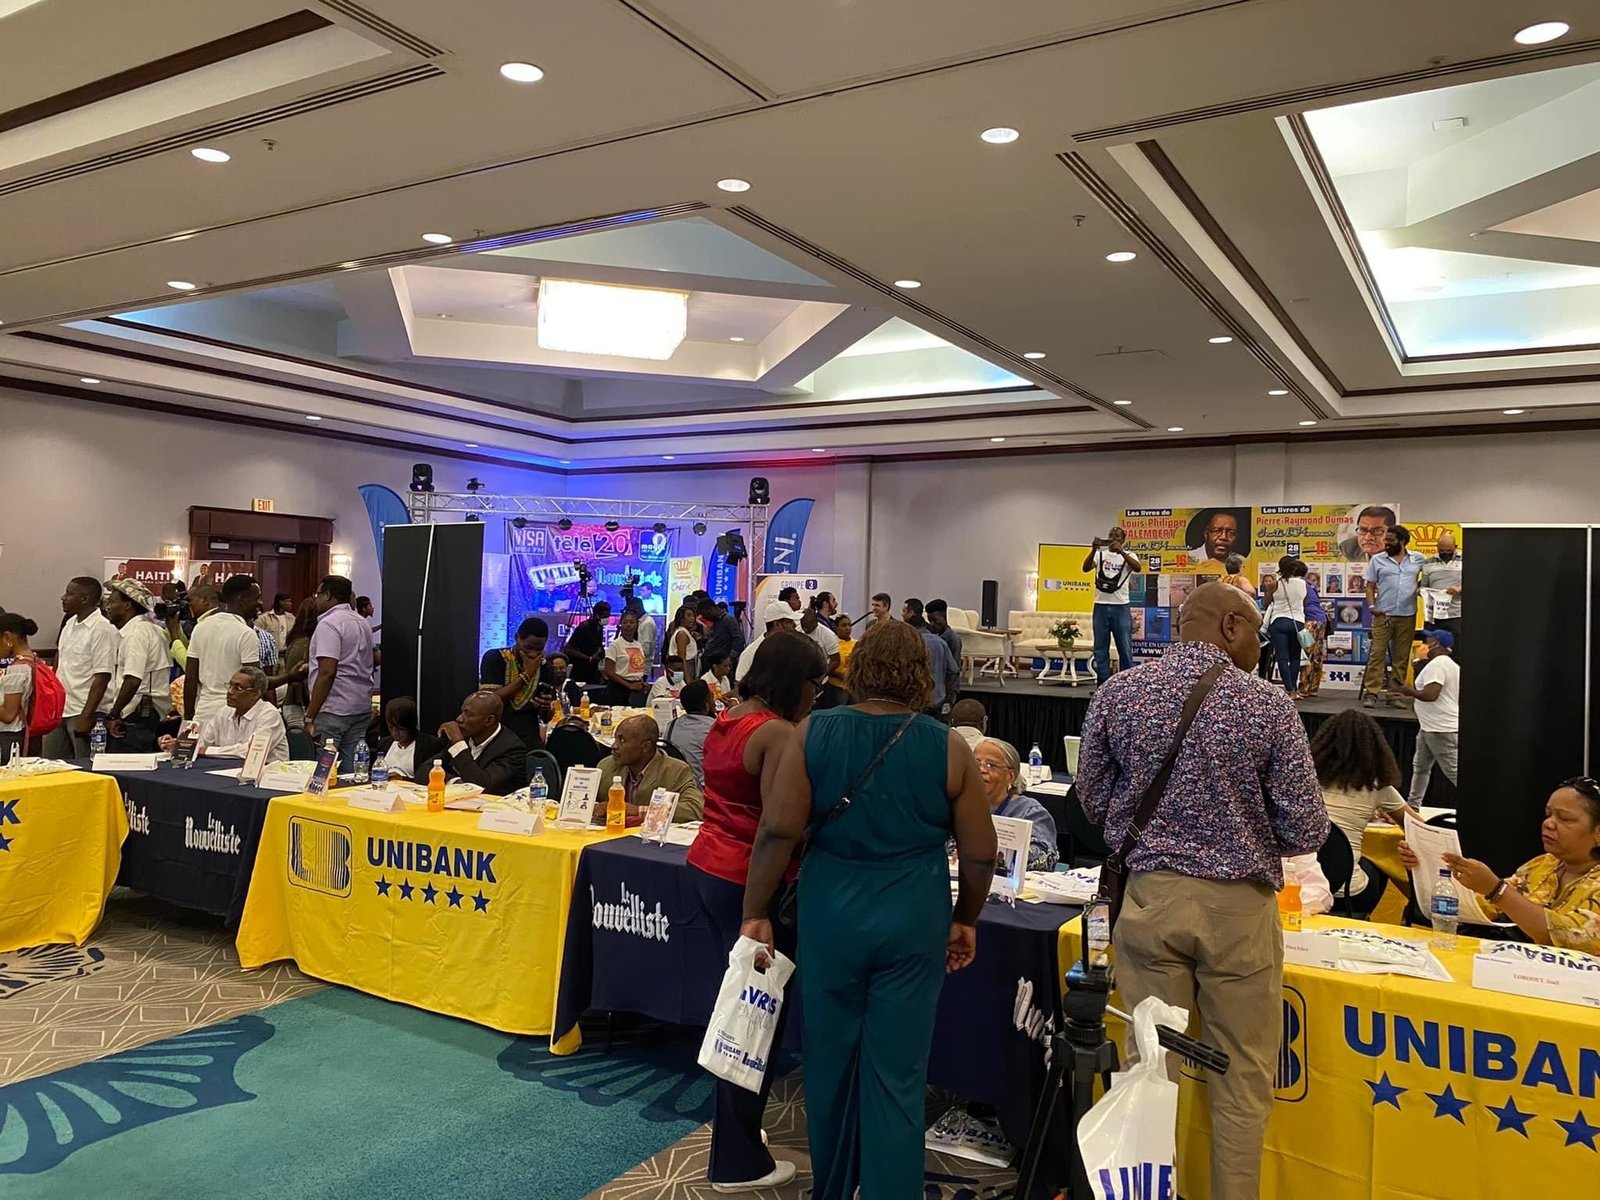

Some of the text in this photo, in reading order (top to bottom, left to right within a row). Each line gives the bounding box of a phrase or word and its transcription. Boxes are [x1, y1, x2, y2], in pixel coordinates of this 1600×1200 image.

[257, 499, 271, 511] EXIT
[1256, 515, 1354, 526] Pierre-Raymond Dumas
[1287, 544, 1299, 552] 28
[1315, 541, 1328, 555] 16
[1175, 554, 1187, 568] 16
[135, 571, 170, 581] HAITI
[808, 581, 814, 590] 3
[366, 836, 498, 884] UNIBANK
